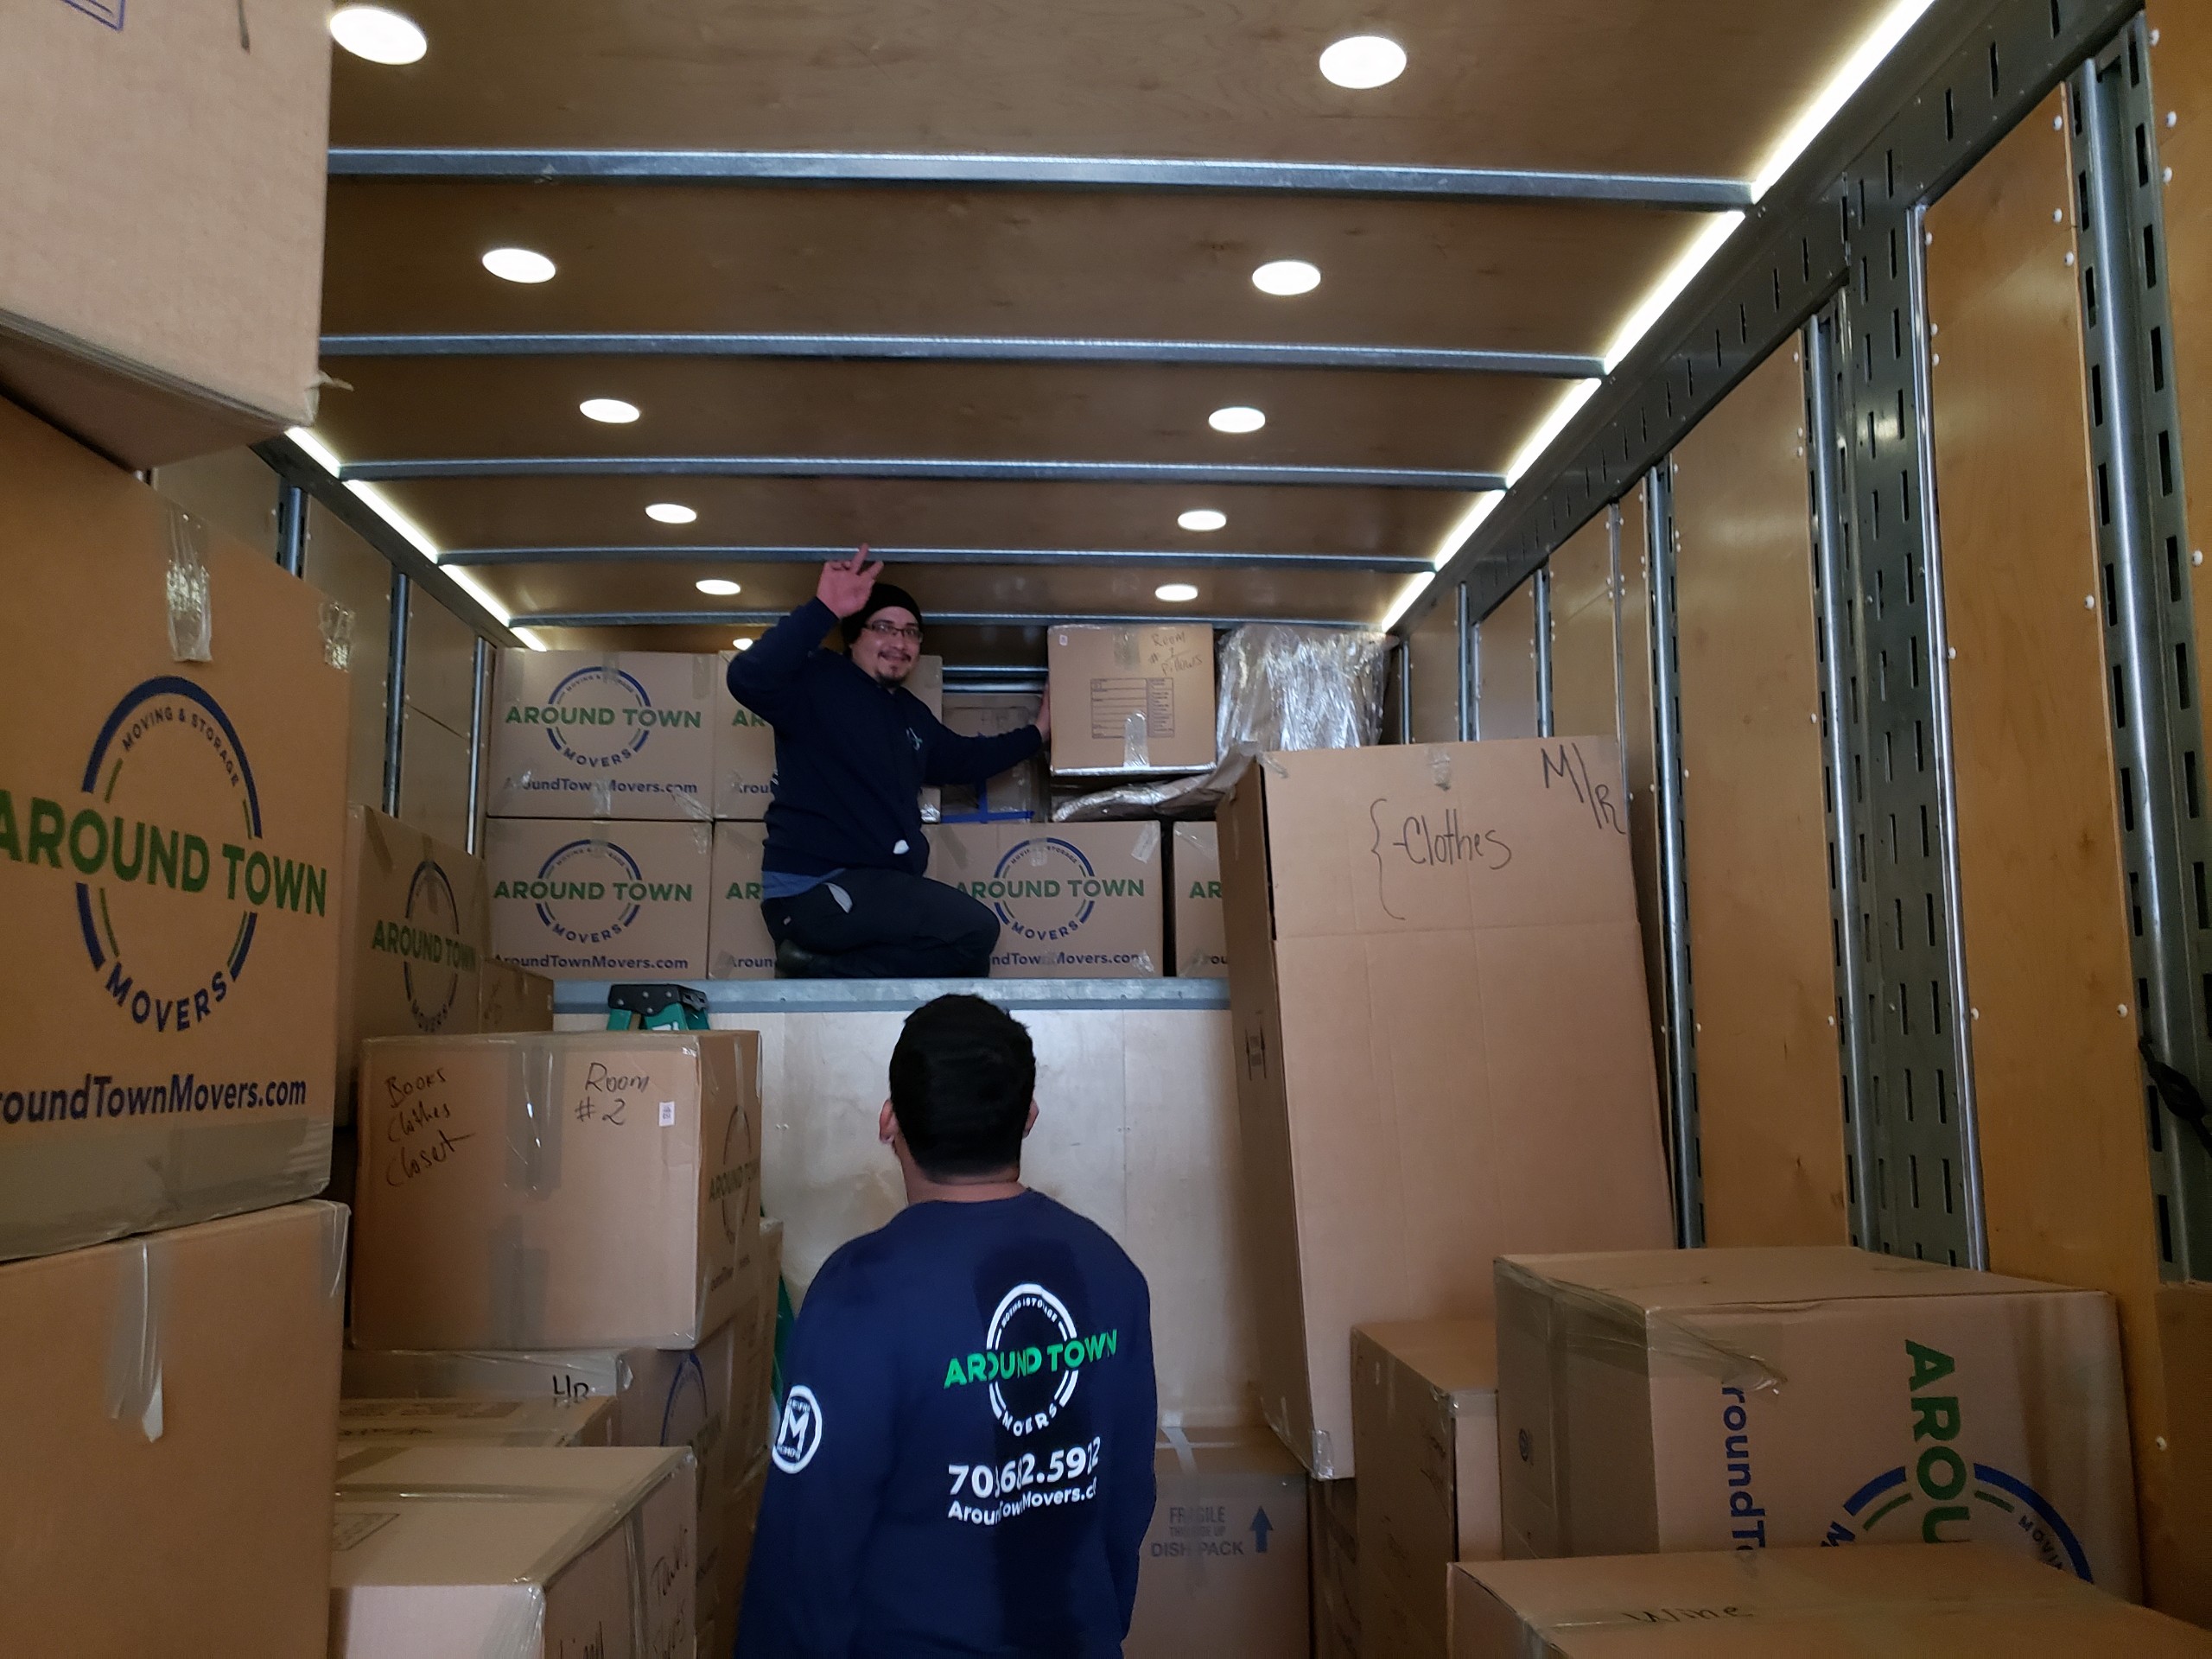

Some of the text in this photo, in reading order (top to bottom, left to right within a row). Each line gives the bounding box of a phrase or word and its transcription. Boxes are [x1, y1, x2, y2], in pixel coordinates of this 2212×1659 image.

[505, 706, 702, 729] AROUND TOWN
[121, 706, 173, 752] MOVING
[191, 713, 239, 788] STORAGE
[563, 747, 632, 768] MOVERS
[0, 788, 327, 918] AROUND TOWN
[493, 881, 692, 902] AROUND TOWN
[957, 879, 1145, 899] AROUND TOWN
[372, 918, 443, 964] AROUND
[551, 922, 622, 944] MOVERS
[1011, 919, 1079, 941] MOVERS
[105, 962, 227, 1033] MOVERS
[585, 1062, 651, 1093] Room
[944, 1328, 1118, 1389] AROUND TOWN
[1001, 1402, 1058, 1437] MOERS
[1169, 1506, 1225, 1523] FRGILE
